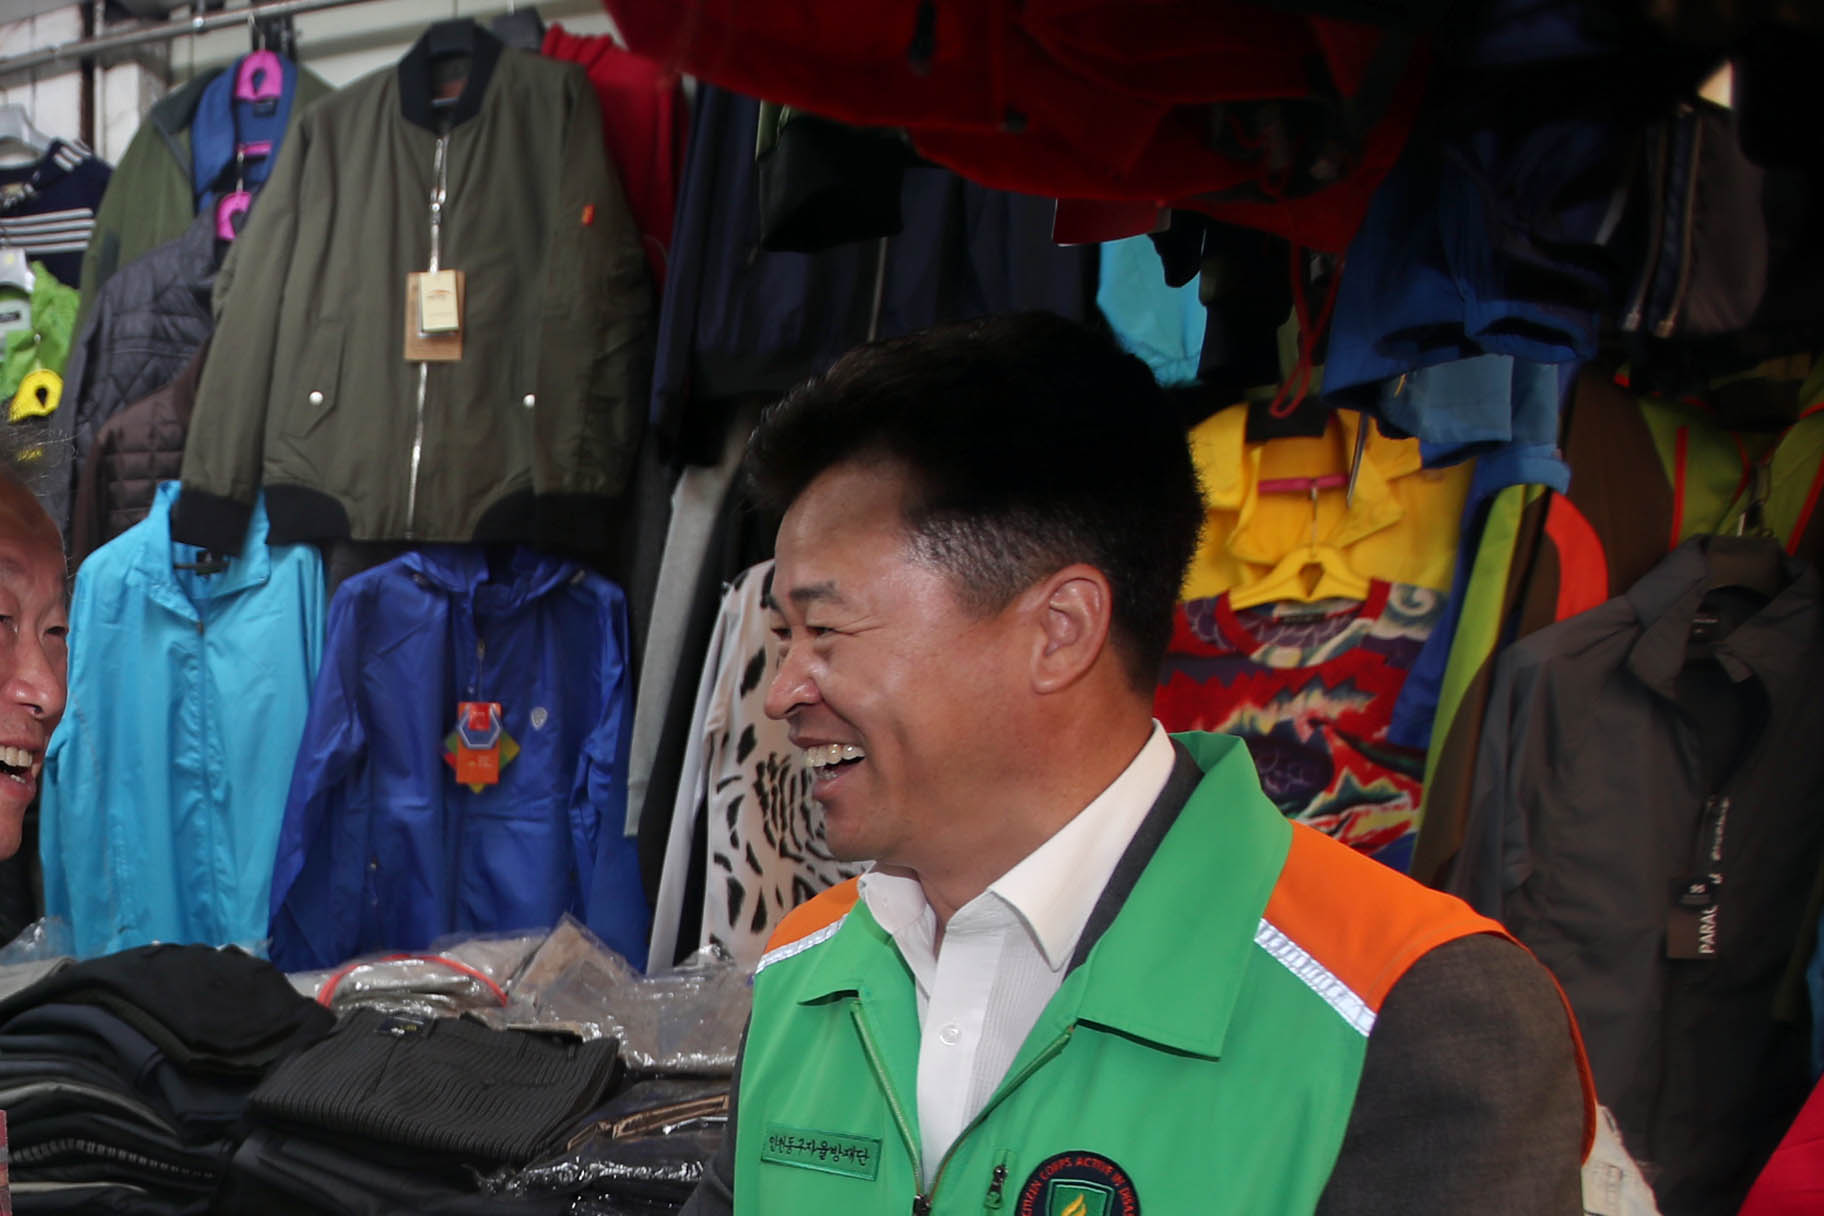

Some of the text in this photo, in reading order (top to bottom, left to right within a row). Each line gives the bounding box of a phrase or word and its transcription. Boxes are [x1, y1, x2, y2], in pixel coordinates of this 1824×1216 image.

[1021, 1180, 1044, 1216] CITIZEN
[1040, 1157, 1073, 1180] CORPS
[1075, 1157, 1115, 1176] ACTIVE
[1111, 1171, 1127, 1187] IN
